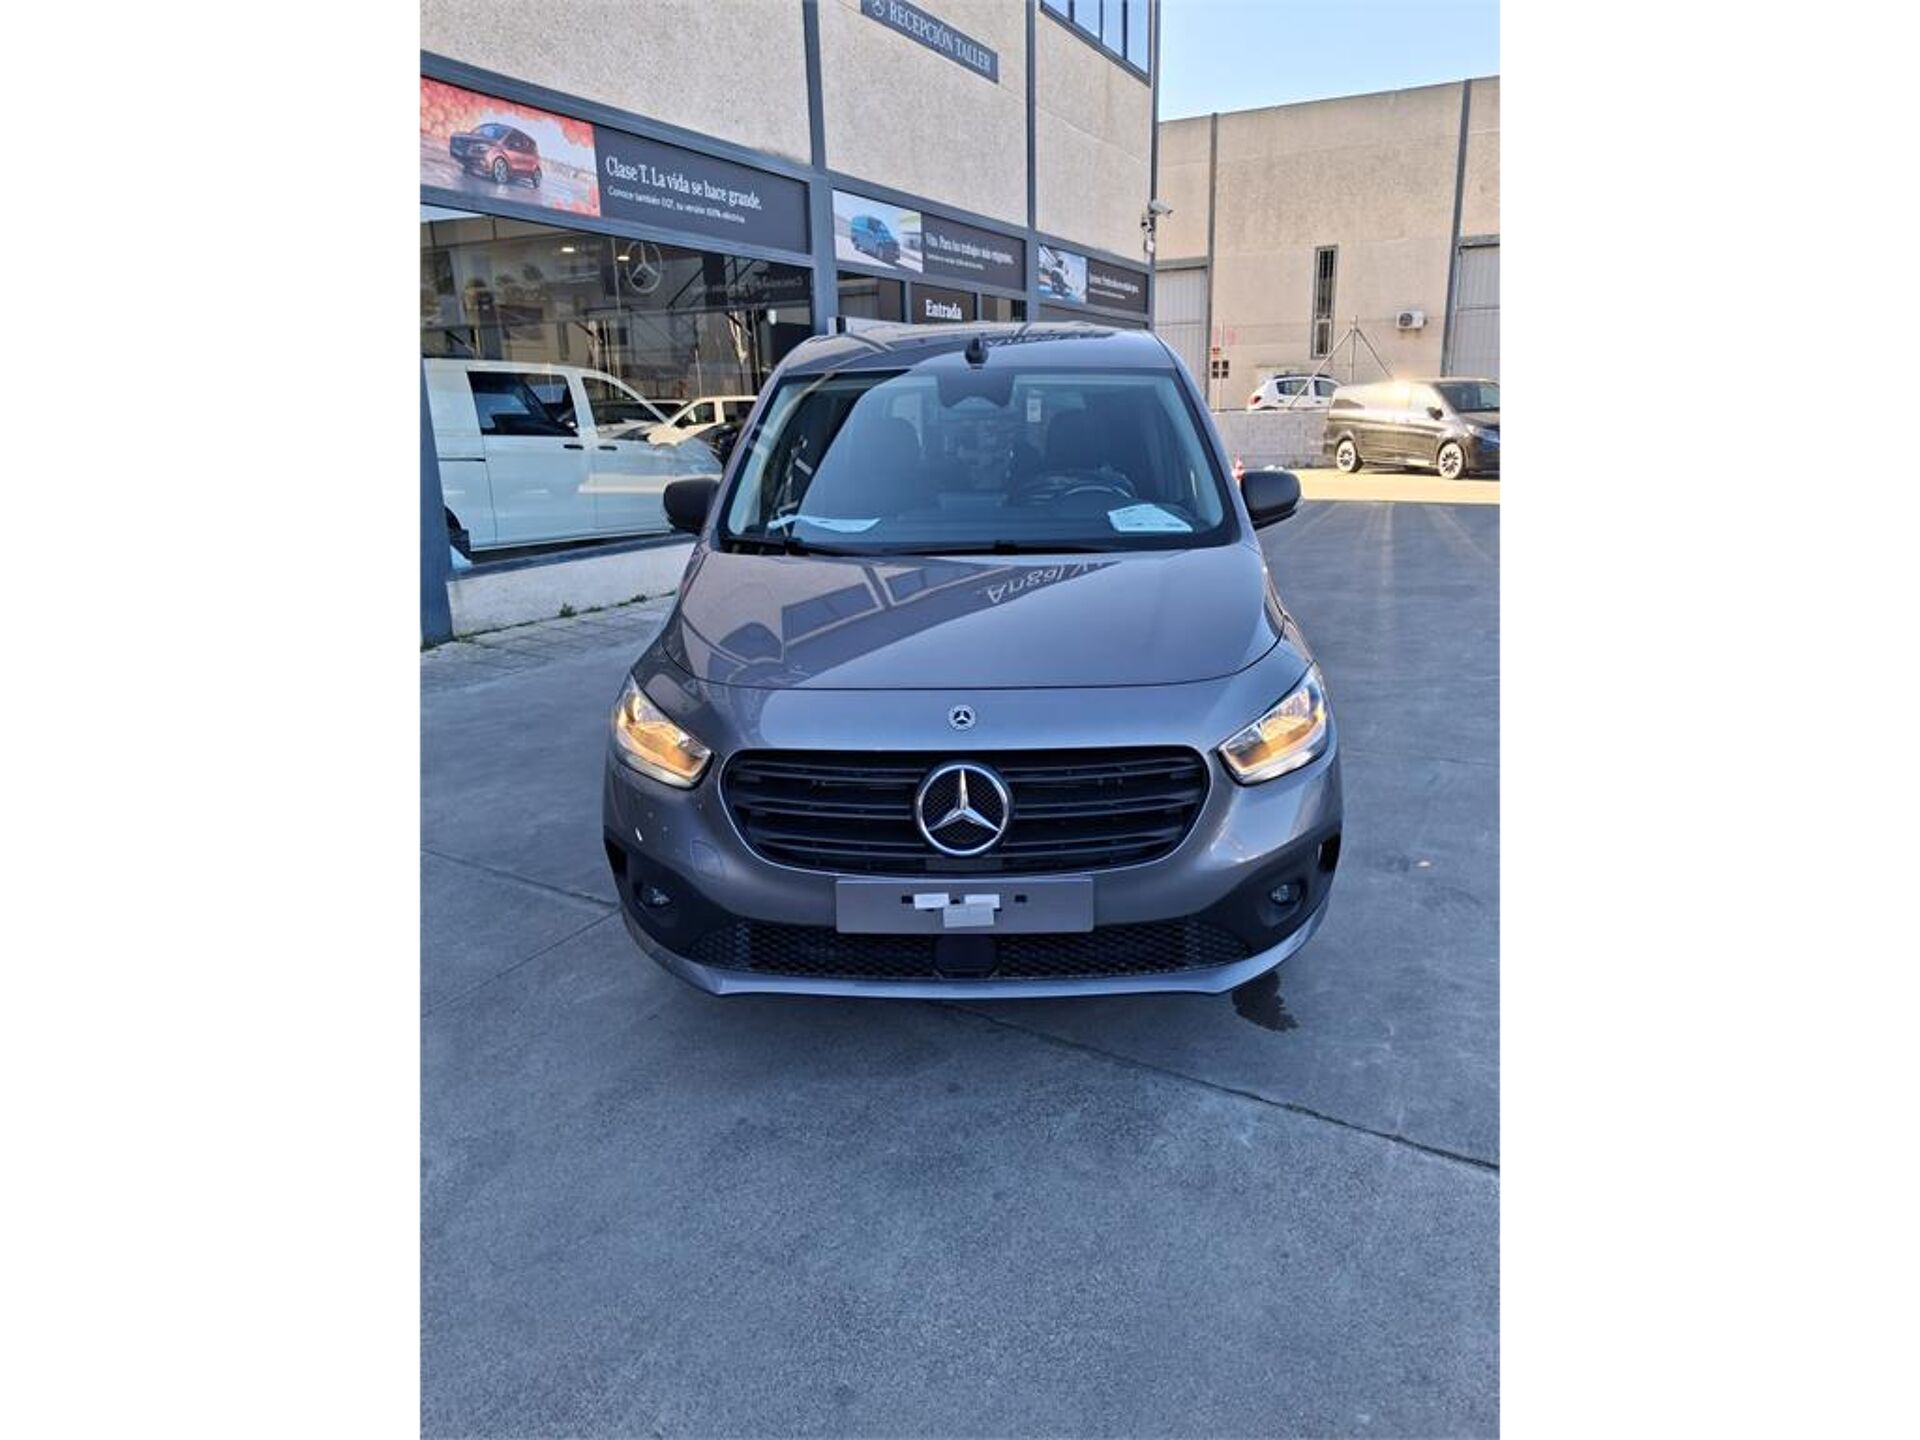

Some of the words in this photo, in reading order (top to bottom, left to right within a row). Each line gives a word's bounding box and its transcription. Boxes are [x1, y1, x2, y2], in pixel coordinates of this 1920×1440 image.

[889, 1, 953, 53] RECEPCIÓN
[954, 37, 991, 73] TALLER
[605, 155, 637, 181] Clase
[638, 164, 650, 185] T.
[652, 167, 666, 188] La
[667, 172, 689, 194] vida
[692, 181, 703, 196] se
[704, 180, 727, 201] hace
[729, 190, 762, 211] grande.
[926, 299, 963, 320] Entrada
